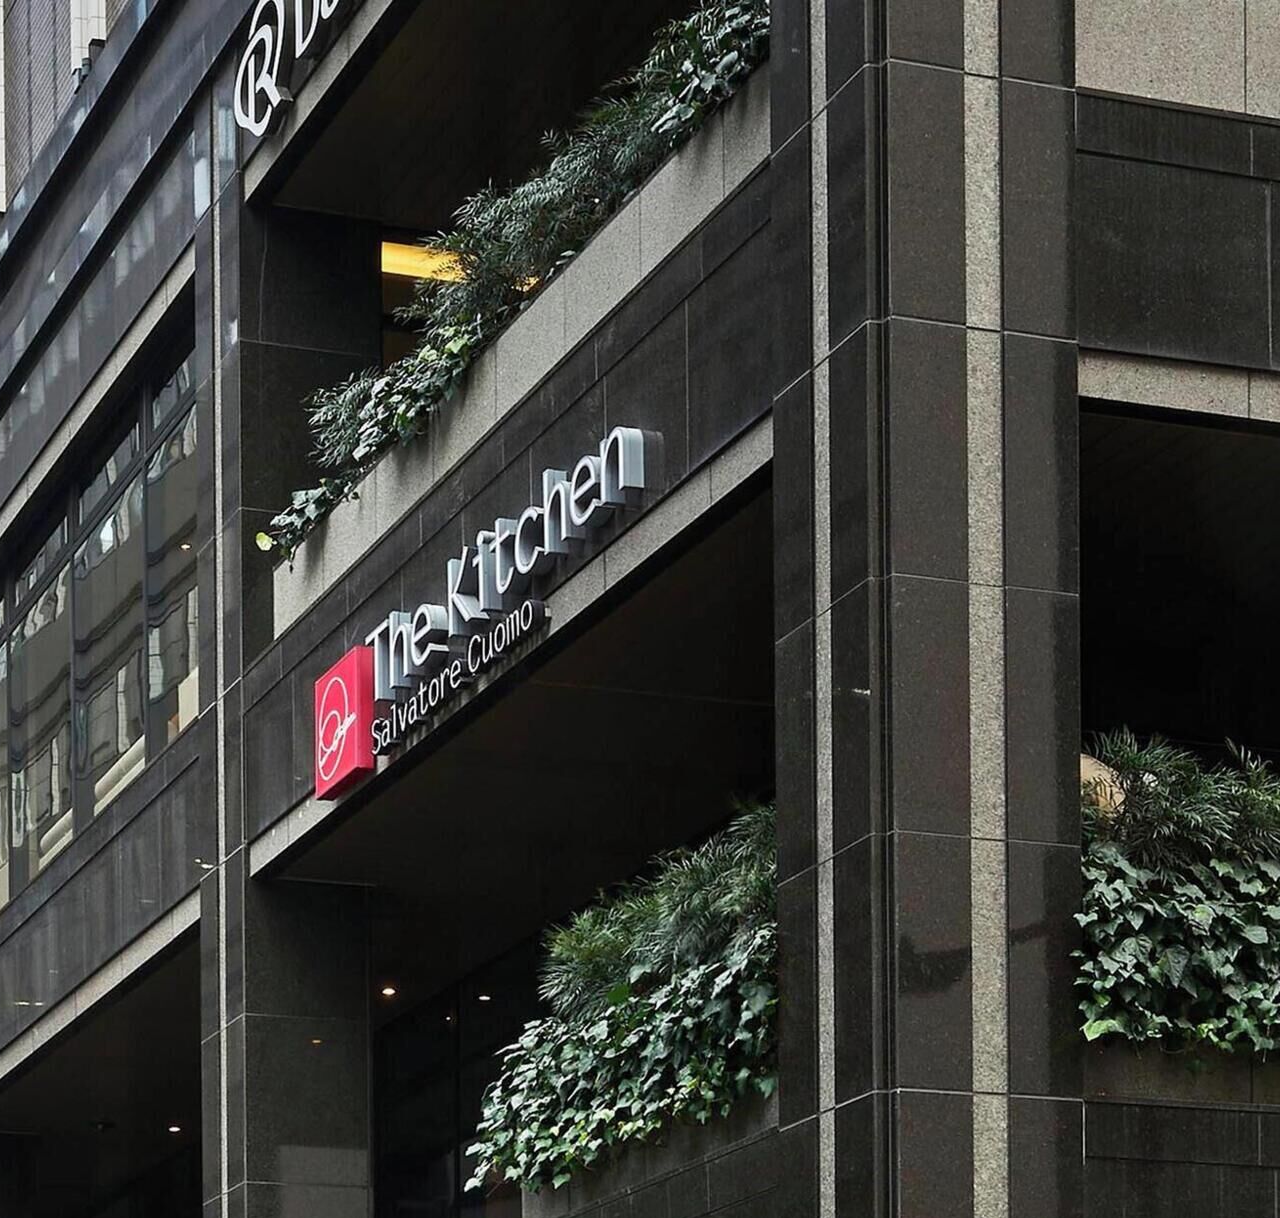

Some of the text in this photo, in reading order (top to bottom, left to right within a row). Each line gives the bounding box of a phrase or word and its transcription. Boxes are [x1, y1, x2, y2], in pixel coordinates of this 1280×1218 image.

[365, 426, 645, 701] The Kitchen
[371, 599, 533, 755] Salvatore Cuomo
